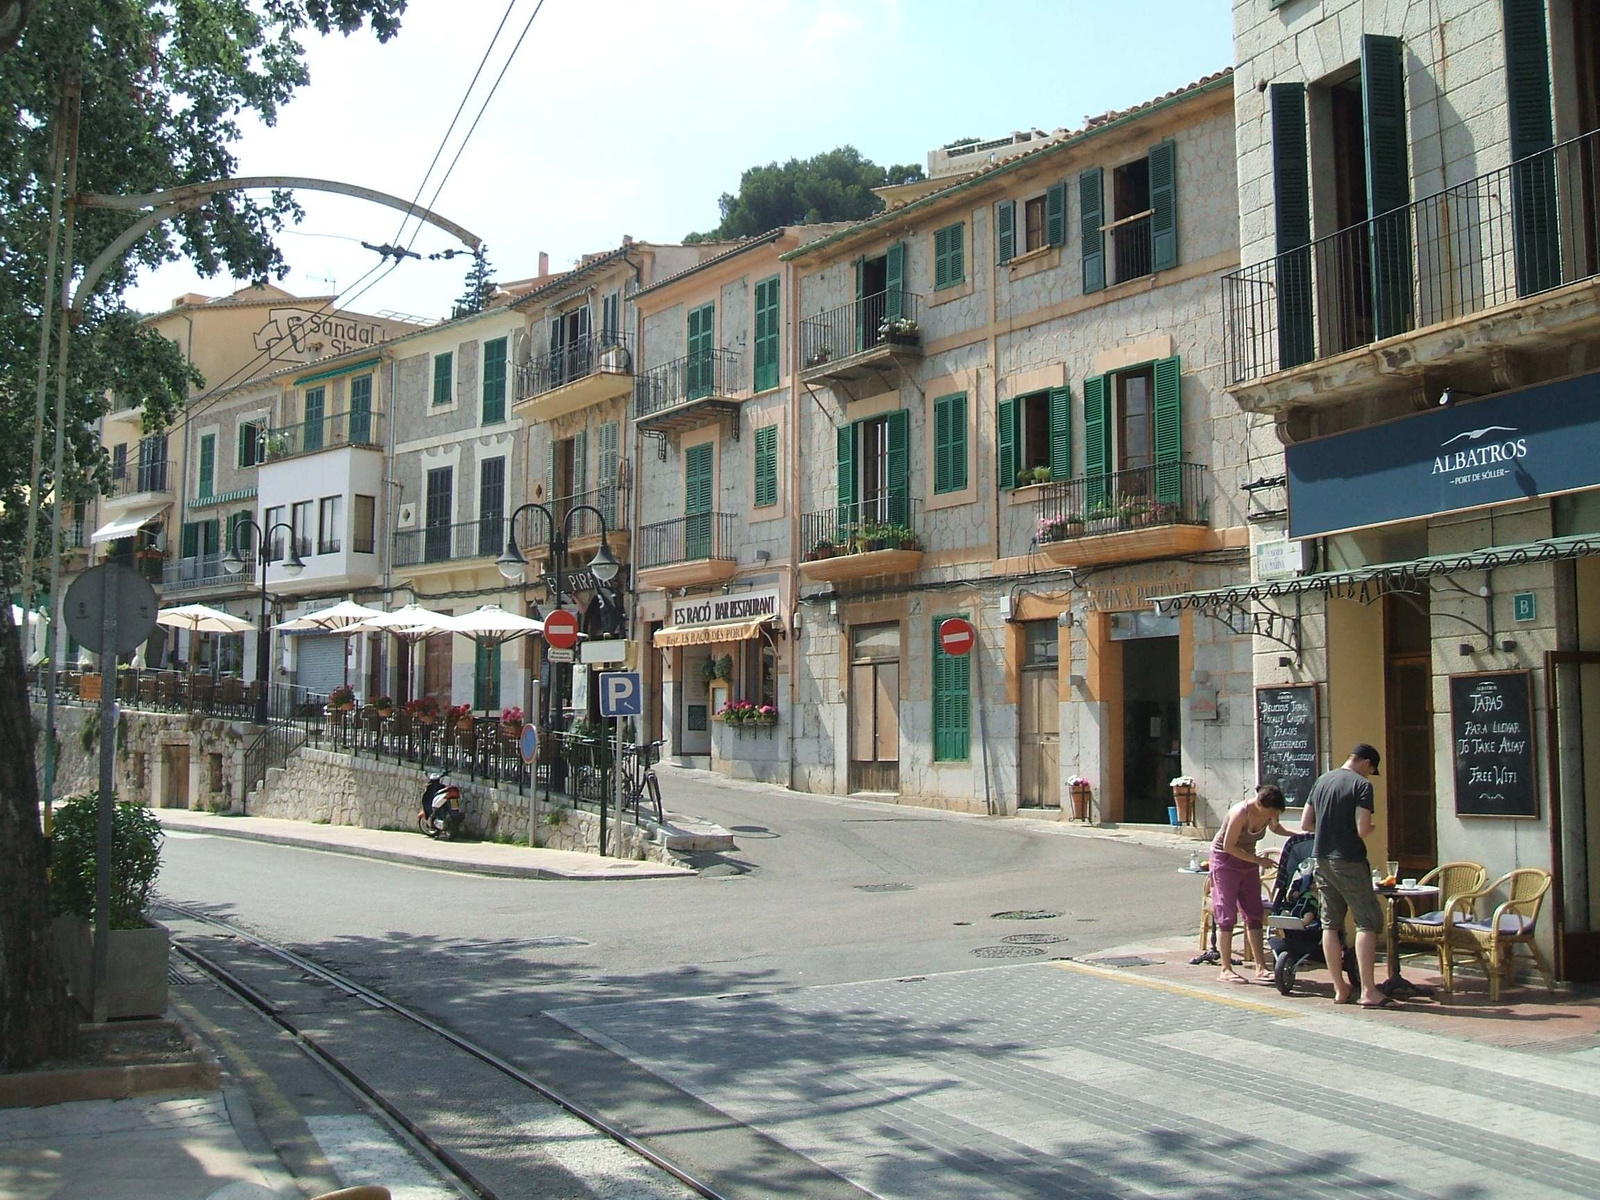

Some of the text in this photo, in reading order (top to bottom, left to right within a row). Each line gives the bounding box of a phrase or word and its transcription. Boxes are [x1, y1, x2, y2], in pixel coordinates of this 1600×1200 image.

[310, 315, 374, 344] Sandal
[1431, 438, 1528, 475] ALBATROS
[1454, 474, 1471, 485] PORT
[1472, 472, 1480, 482] DE
[674, 596, 775, 625] ES RACÓ BAR RESTAURANT
[1520, 600, 1529, 614] B
[681, 634, 689, 643] ES
[711, 630, 724, 640] DES
[726, 627, 745, 638] PORT
[608, 677, 633, 711] P
[1469, 694, 1503, 713] TAPAS
[1464, 721, 1487, 735] PARA
[1458, 736, 1525, 755] TO TAKE AWAY
[1468, 766, 1492, 785] FREE
